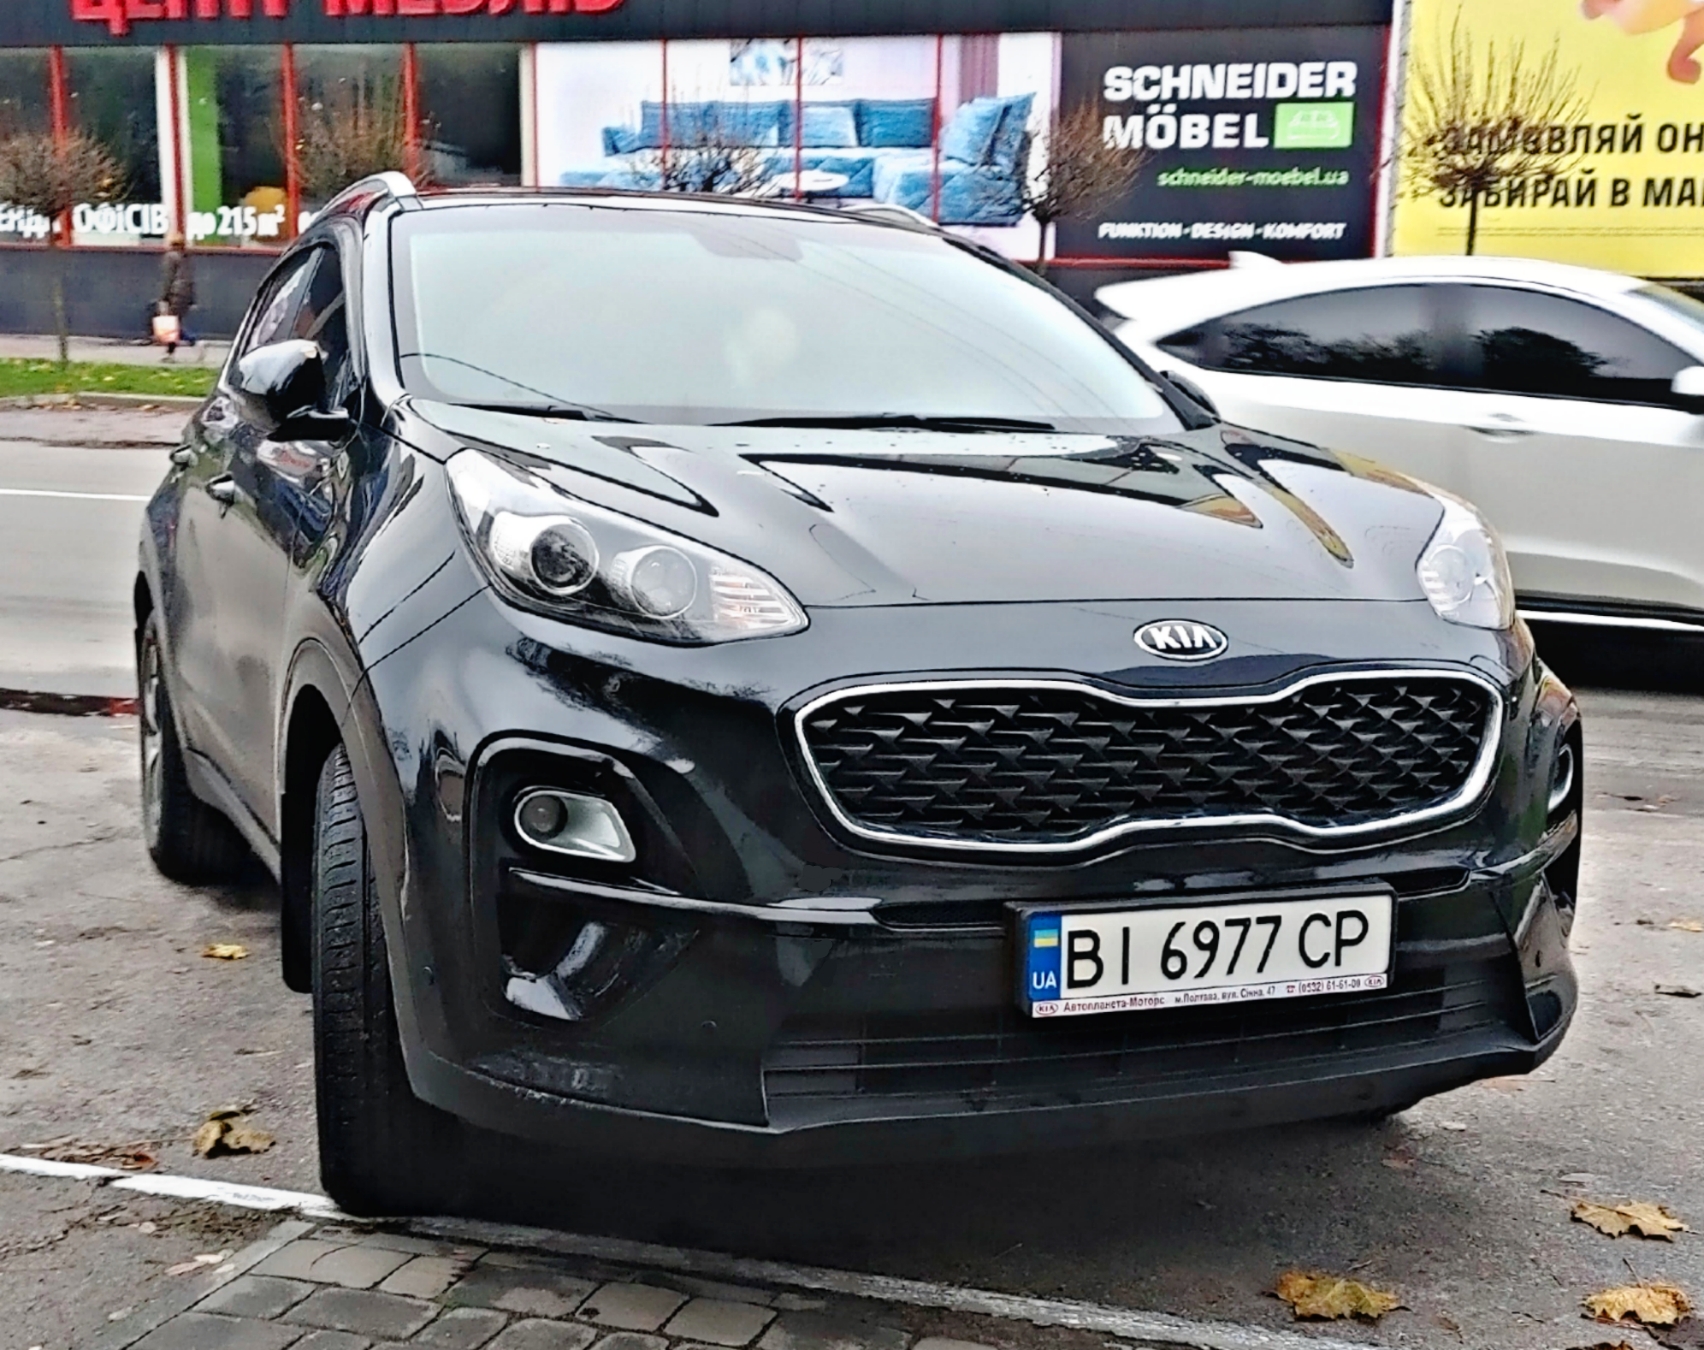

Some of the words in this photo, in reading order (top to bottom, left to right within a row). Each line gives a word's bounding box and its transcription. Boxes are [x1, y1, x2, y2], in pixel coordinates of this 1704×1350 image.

[1103, 61, 1358, 101] SCHNEIDER
[1103, 103, 1270, 150] MÖBEL
[1156, 167, 1350, 186] schneider-moebel.ua
[1608, 178, 1631, 207] В
[1642, 178, 1704, 208] МА
[217, 206, 256, 235] 215
[1098, 222, 1182, 238] FUNKTION
[1191, 222, 1254, 238] DESIGN
[1262, 222, 1347, 239] KOMFORT
[1147, 625, 1218, 650] KIA
[1066, 927, 1130, 989] BI
[1160, 915, 1282, 980] 6977
[1298, 909, 1369, 968] CP
[1032, 971, 1057, 990] UA
